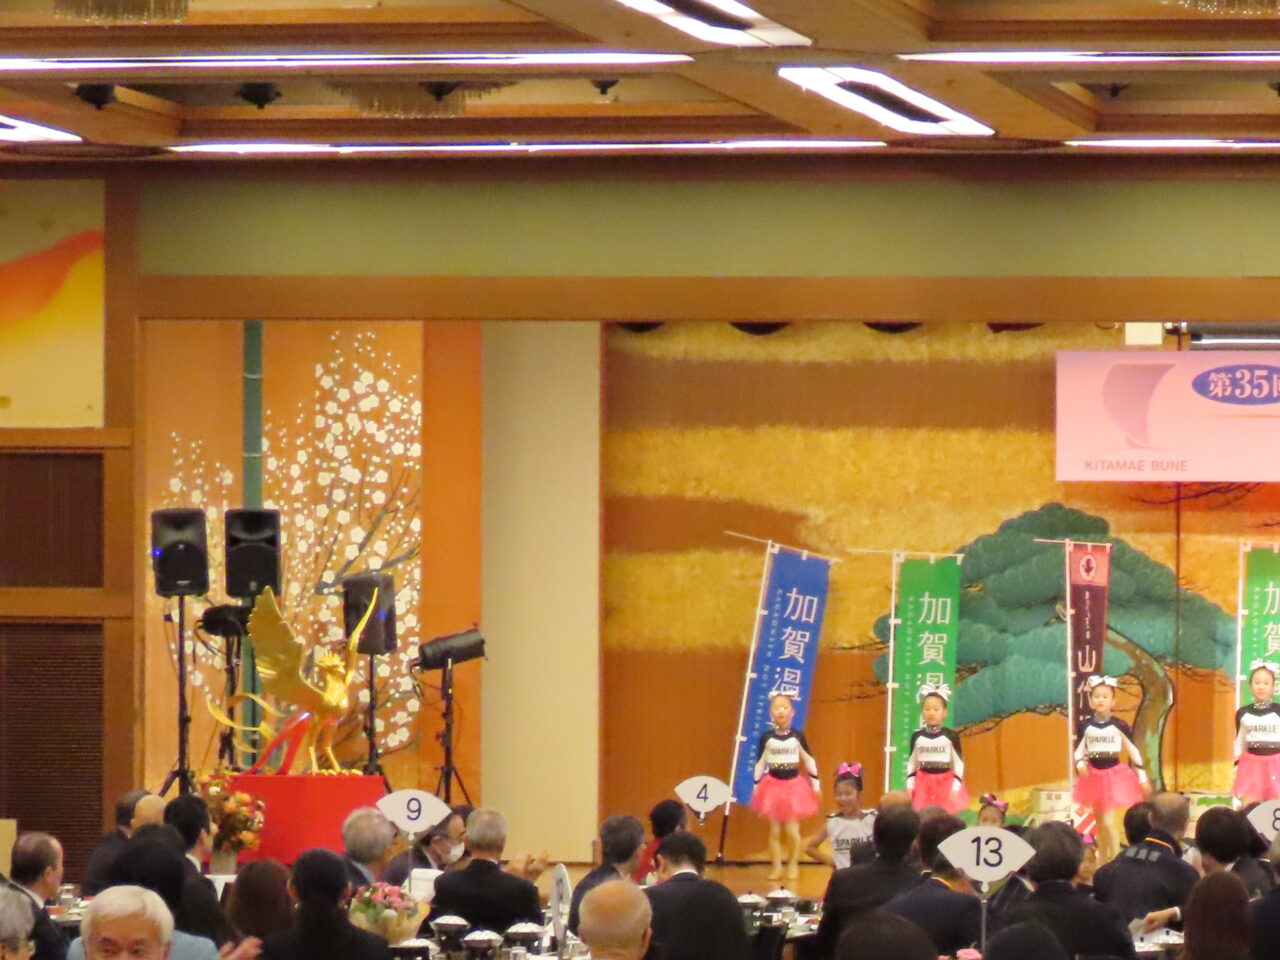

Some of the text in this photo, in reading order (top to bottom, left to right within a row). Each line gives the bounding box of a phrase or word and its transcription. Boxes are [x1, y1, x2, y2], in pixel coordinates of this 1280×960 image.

[1084, 459, 1189, 473] KITAMAE BUNE
[1247, 725, 1278, 734] SPARKLE
[1087, 736, 1115, 745] SPARKLE
[918, 746, 947, 754] SPARKLE
[695, 782, 710, 803] 4
[406, 797, 422, 821] 9
[971, 837, 1004, 868] 13
